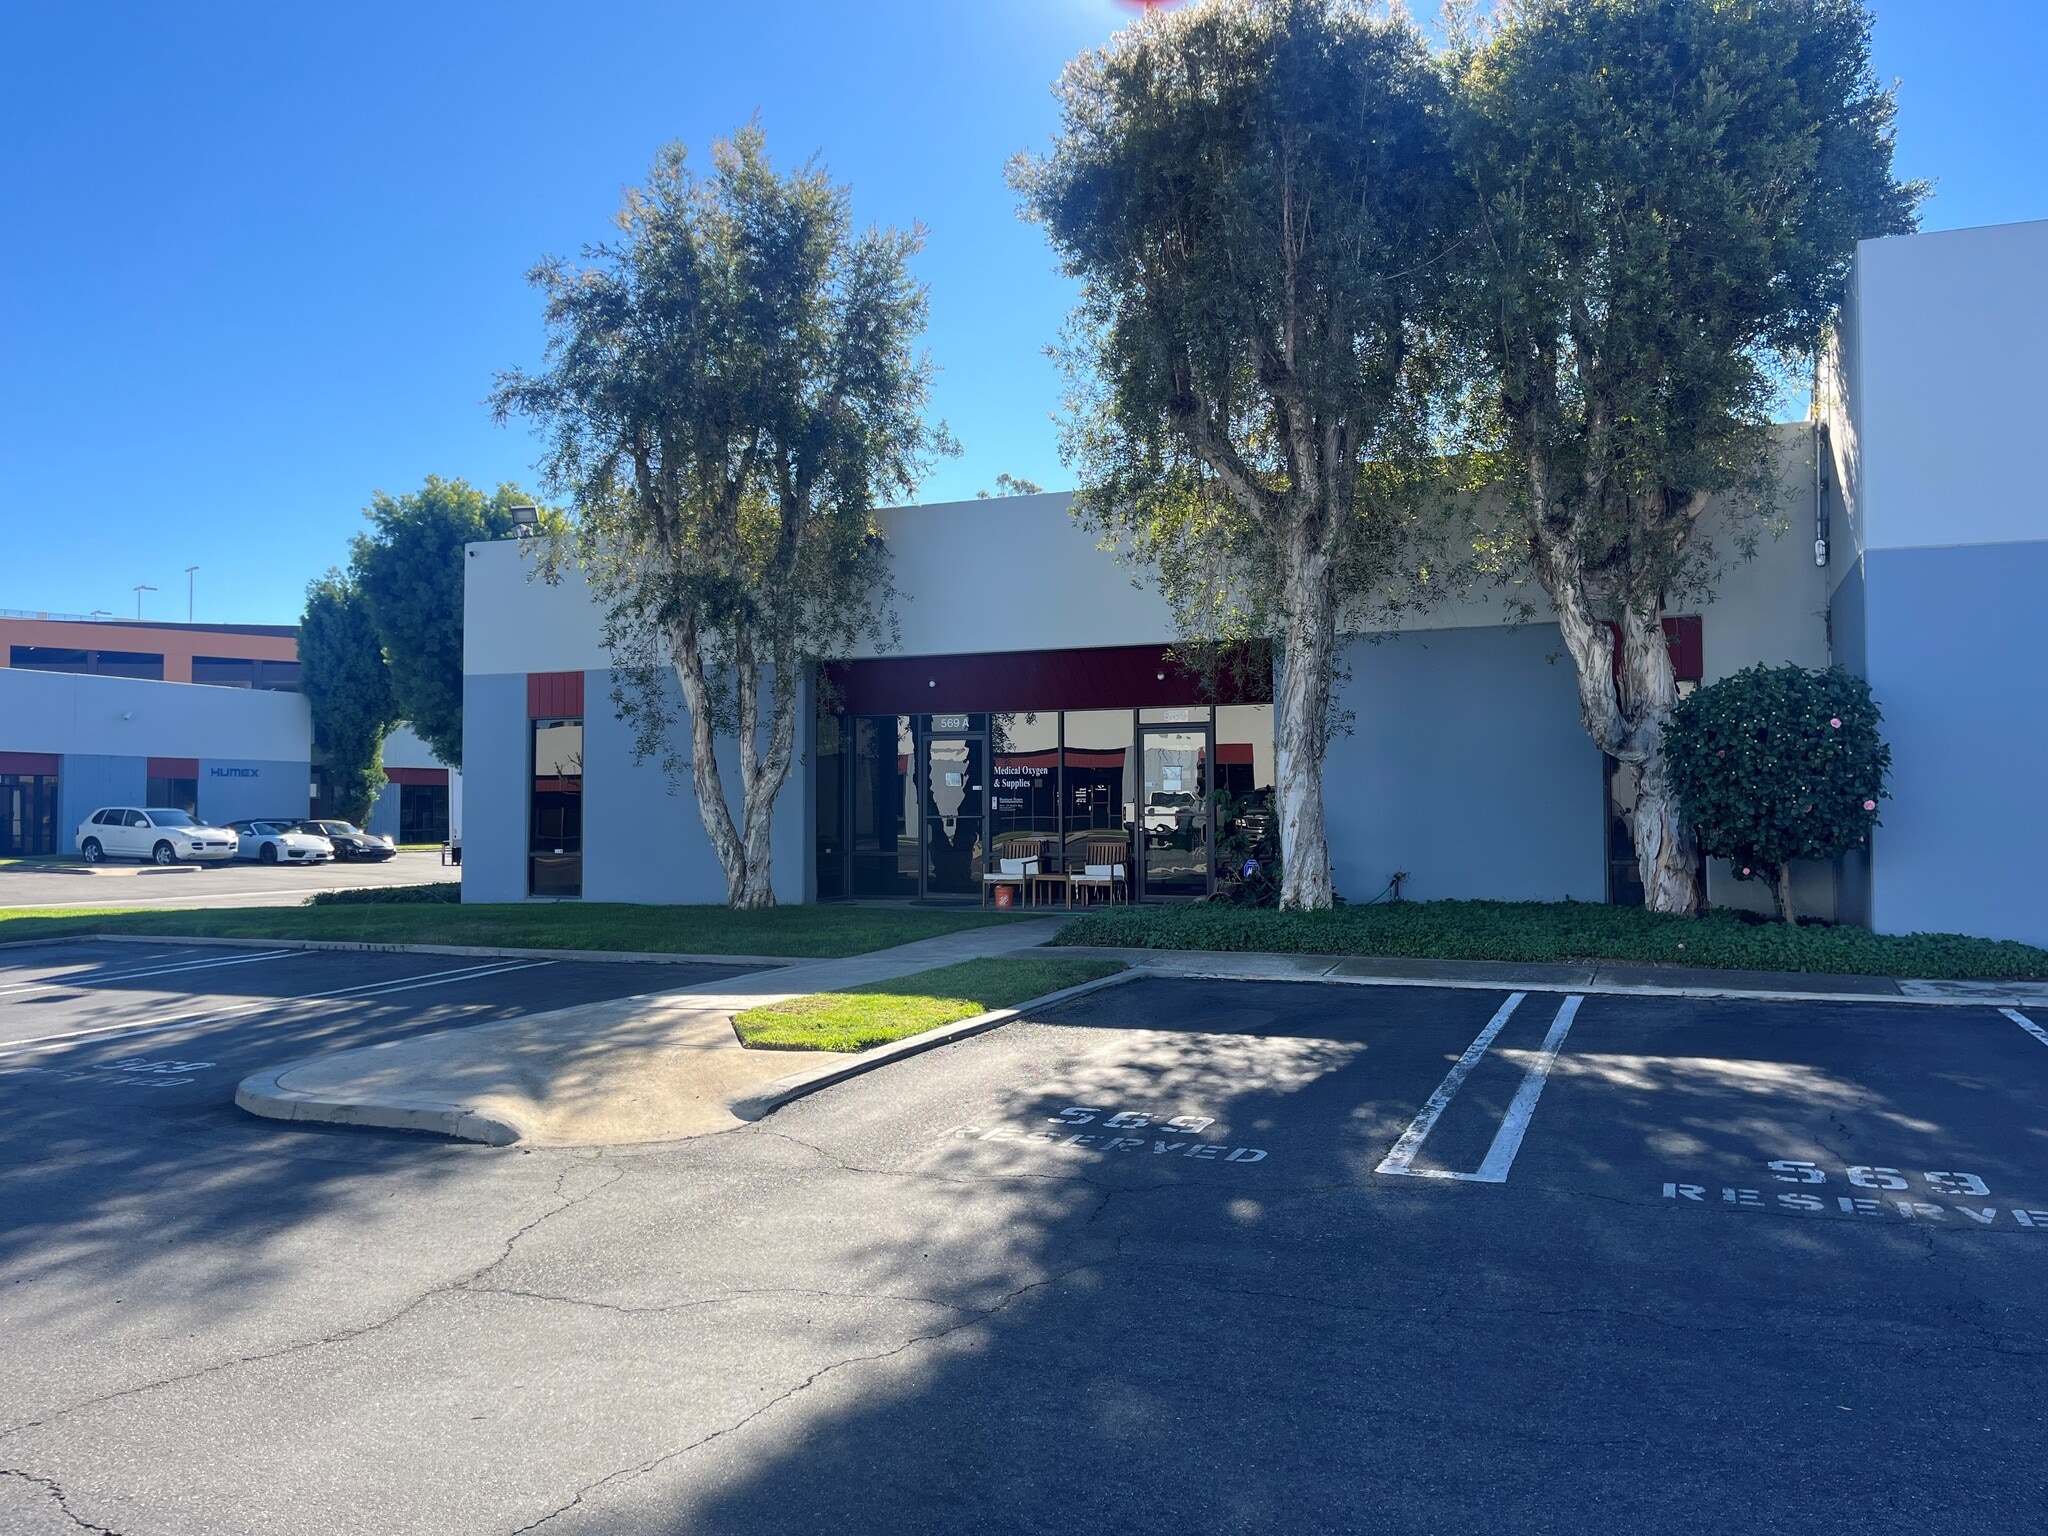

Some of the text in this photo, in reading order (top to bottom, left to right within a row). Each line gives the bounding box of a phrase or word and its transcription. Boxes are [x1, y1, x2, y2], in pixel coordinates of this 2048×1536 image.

[941, 718, 970, 728] 569 A
[210, 767, 259, 777] HUMEX
[993, 765, 1048, 777] Medical Oxygen
[993, 778, 1031, 790] & Supplies
[1047, 1106, 1216, 1135] 569
[936, 1125, 1269, 1164] RESERVED
[1767, 1159, 1991, 1196] 569
